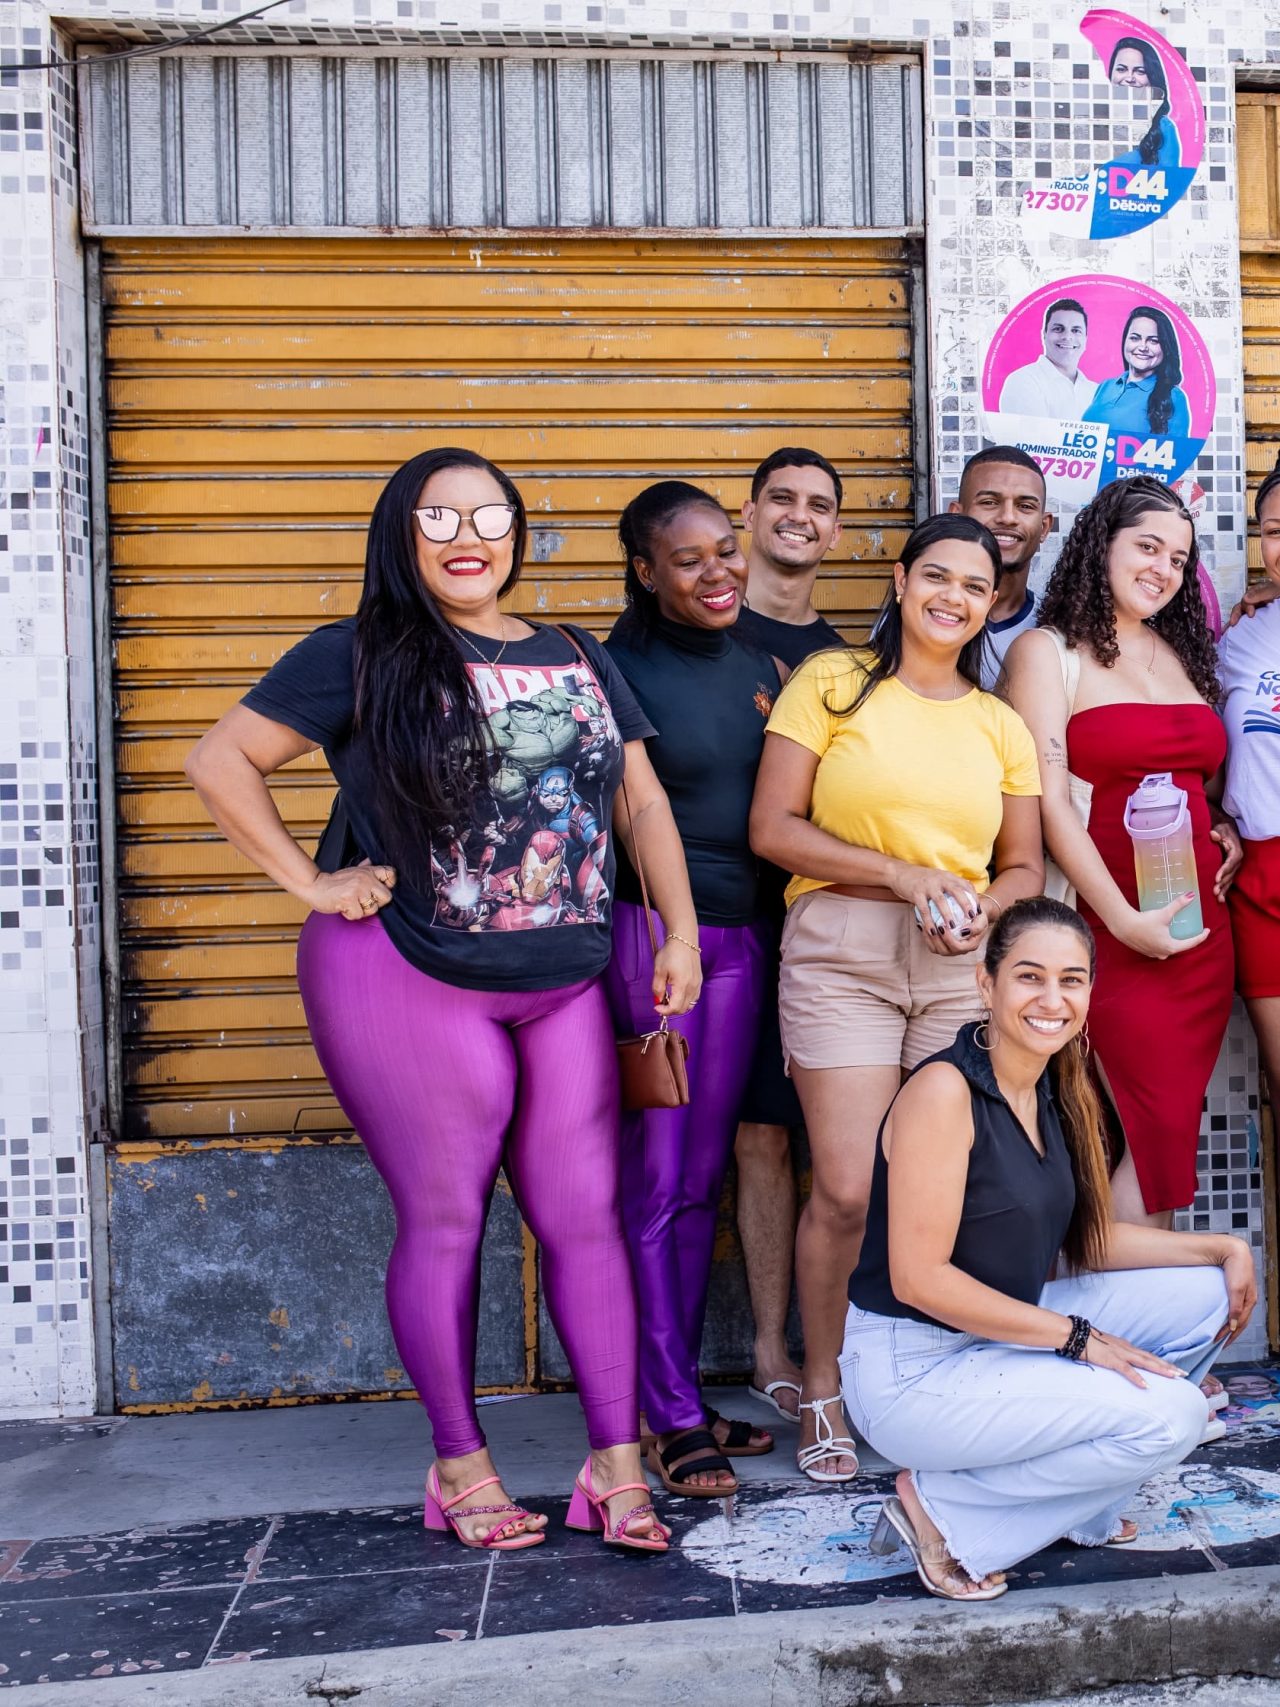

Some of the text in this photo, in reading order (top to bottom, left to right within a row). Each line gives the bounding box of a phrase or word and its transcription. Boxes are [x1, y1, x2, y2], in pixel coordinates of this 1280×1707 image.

[1060, 422, 1101, 431] VEREADOR
[1062, 430, 1098, 449] LÉO
[1015, 443, 1098, 460] ADMINISTRADOR
